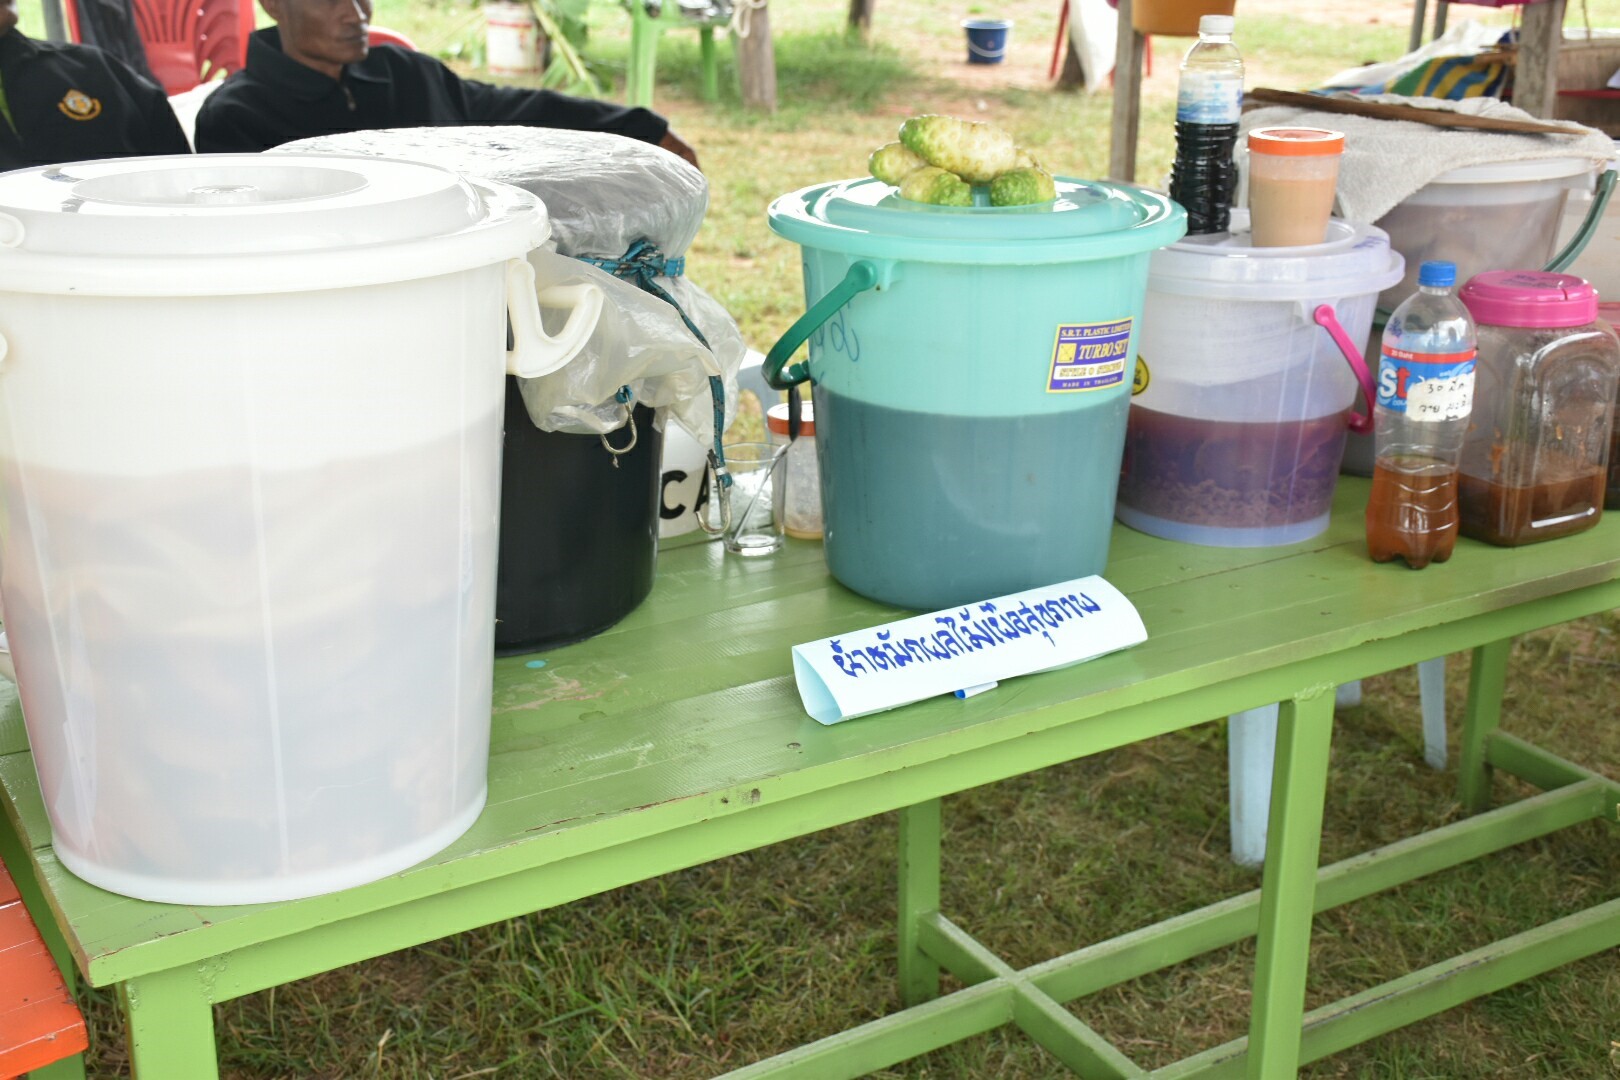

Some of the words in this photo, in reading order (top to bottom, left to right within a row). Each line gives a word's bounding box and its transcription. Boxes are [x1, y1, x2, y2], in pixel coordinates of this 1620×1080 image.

[1083, 327, 1110, 337] PLASTIC
[1078, 342, 1114, 360] TURBO
[1112, 338, 1129, 356] SET
[1094, 377, 1118, 385] THAILAND
